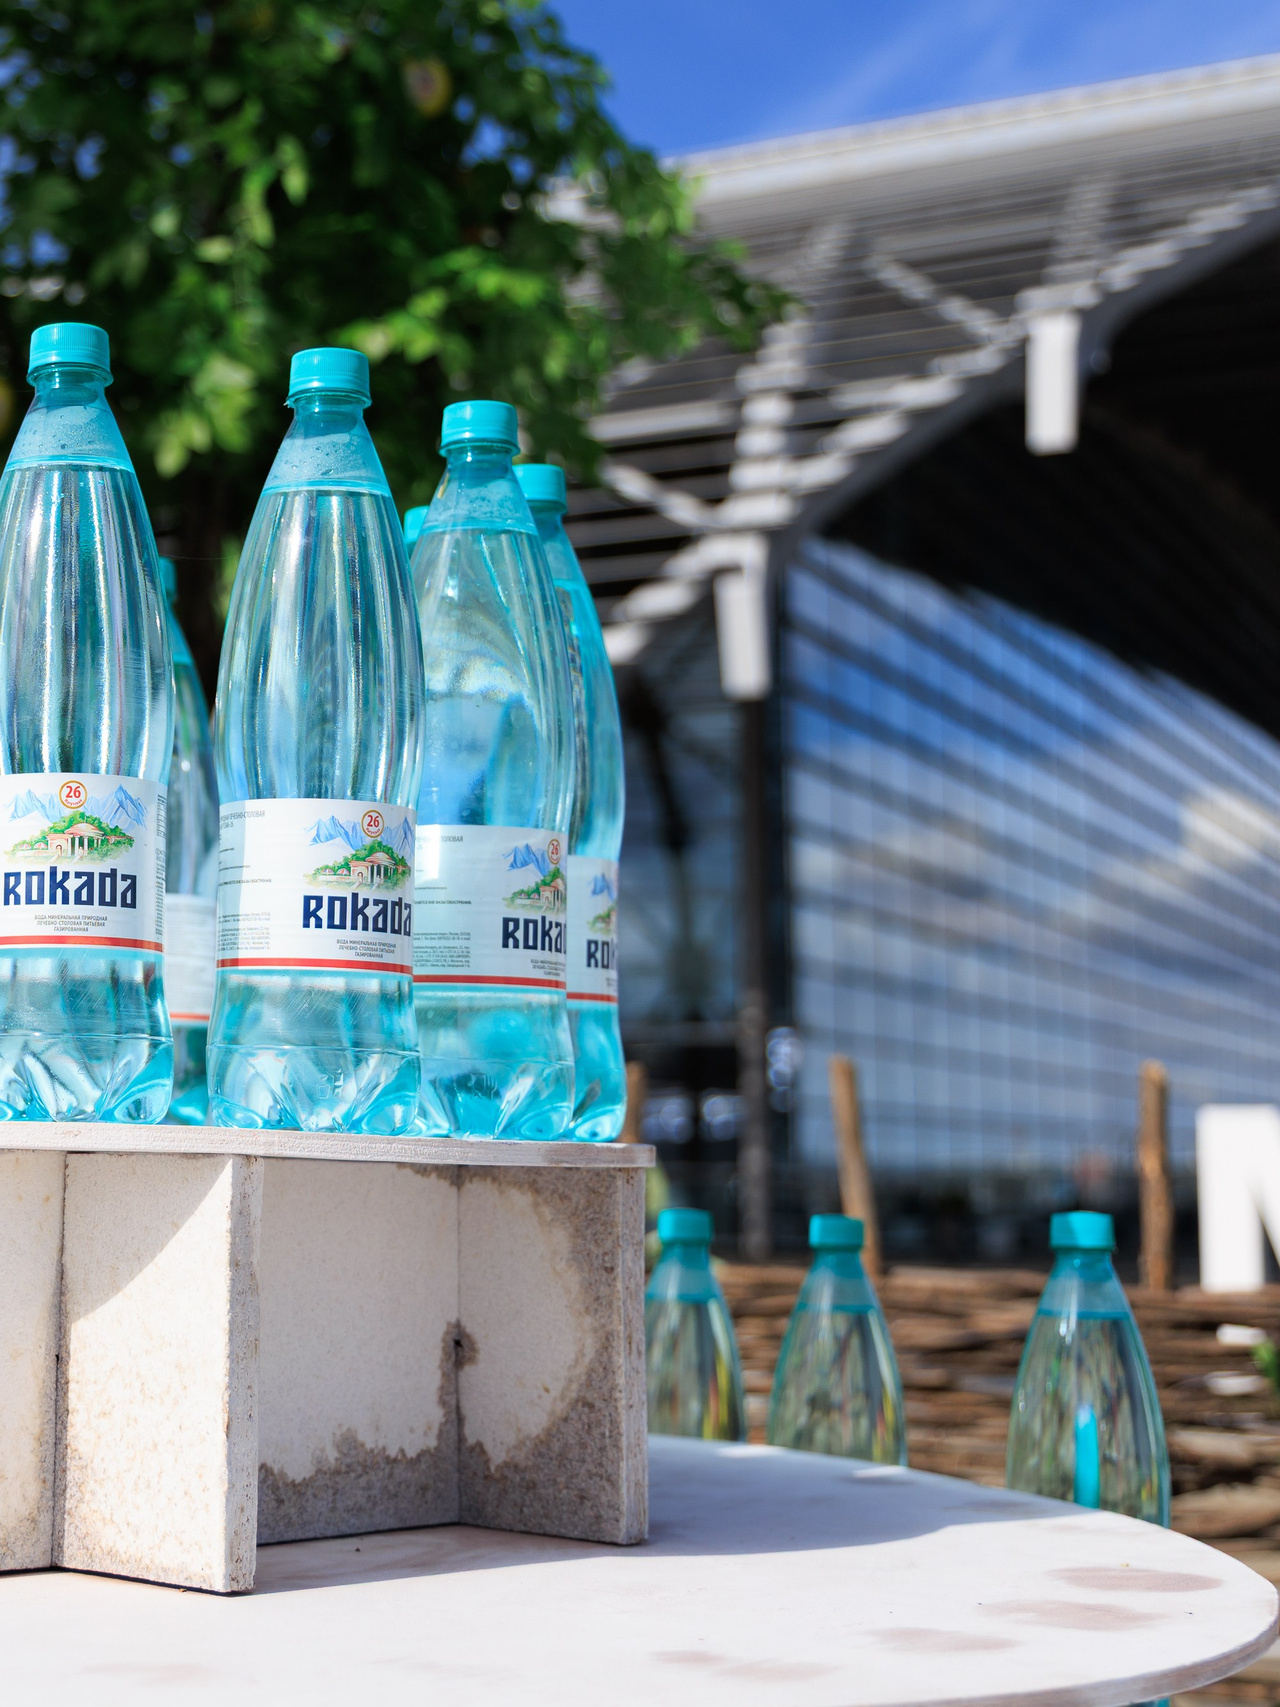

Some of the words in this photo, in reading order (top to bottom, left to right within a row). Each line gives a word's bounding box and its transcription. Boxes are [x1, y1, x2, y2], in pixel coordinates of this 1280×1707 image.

[65, 785, 81, 798] 26
[367, 814, 380, 828] 26
[551, 843, 559, 856] 26
